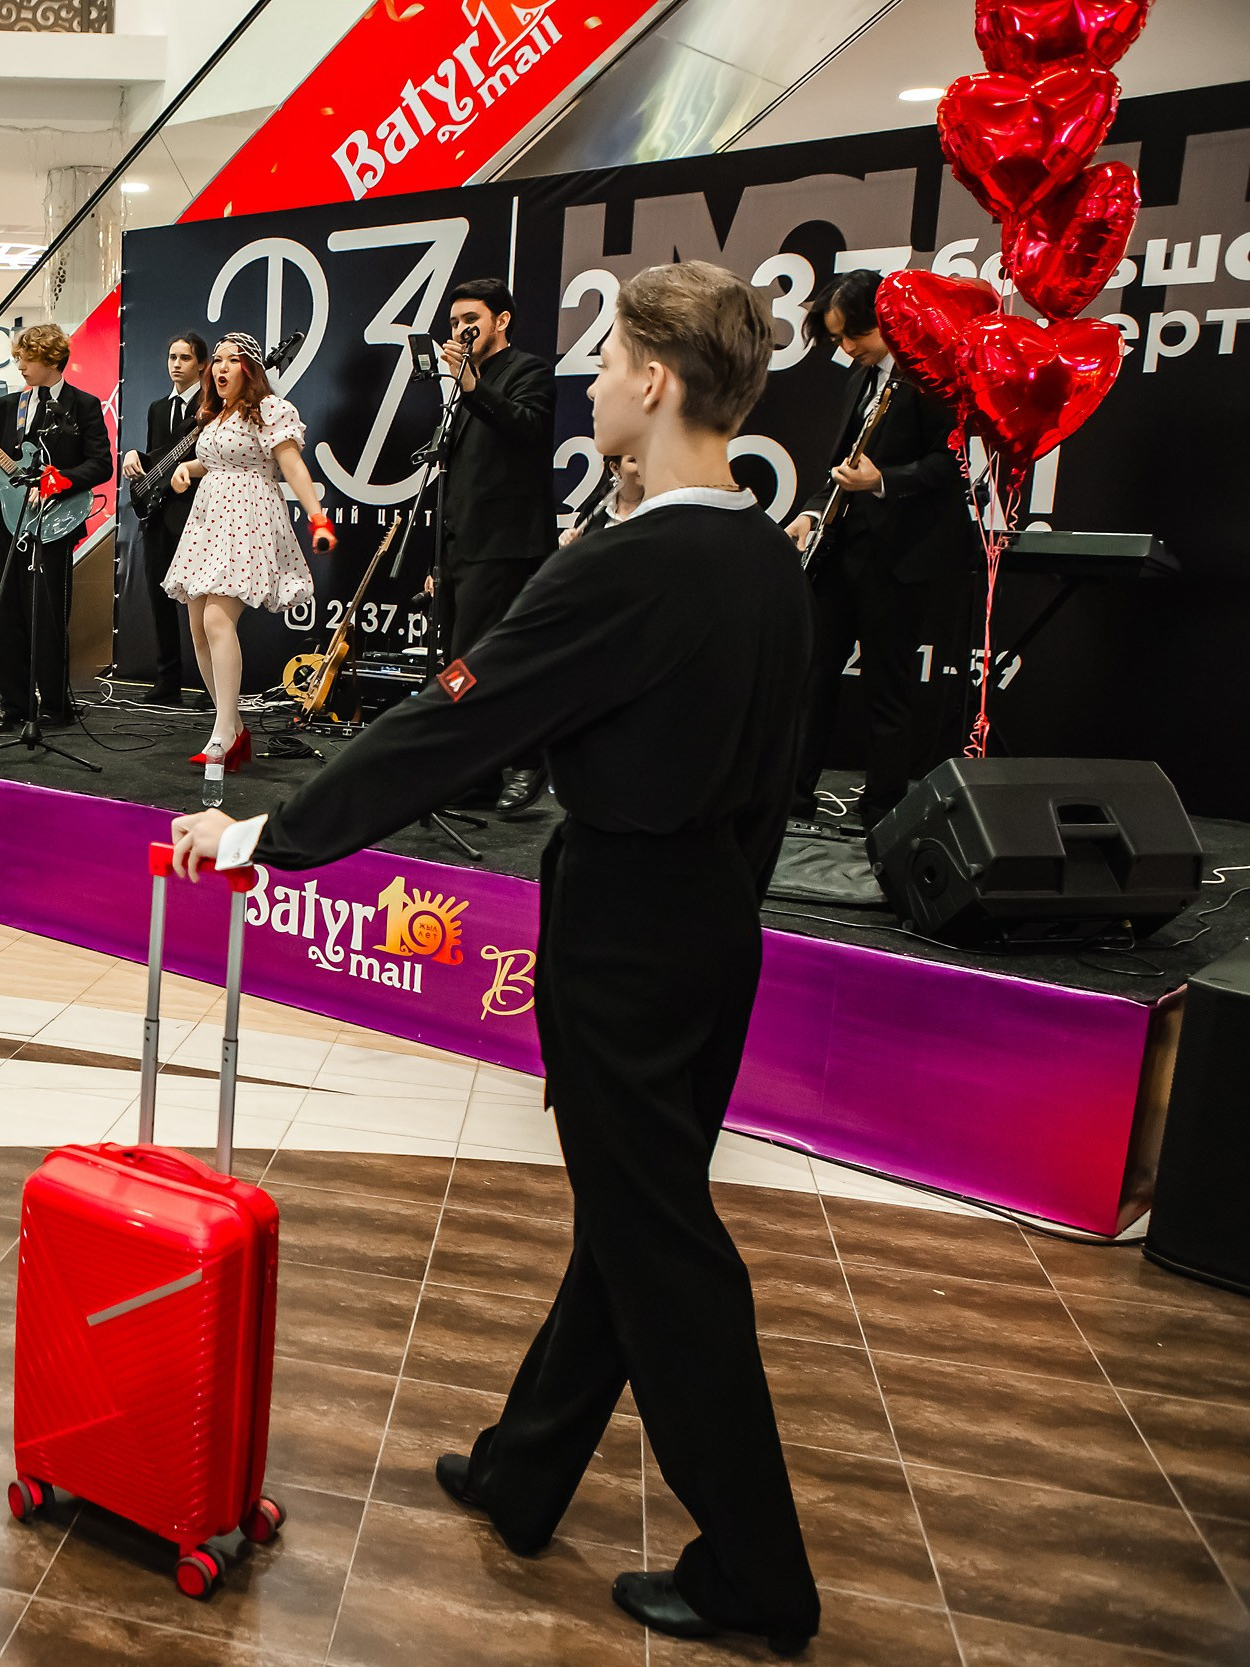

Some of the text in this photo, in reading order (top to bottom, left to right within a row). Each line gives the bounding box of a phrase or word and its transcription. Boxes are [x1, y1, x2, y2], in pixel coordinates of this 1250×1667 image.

[477, 15, 563, 108] mall
[331, 30, 485, 201] Batyr
[348, 953, 423, 994] mall
